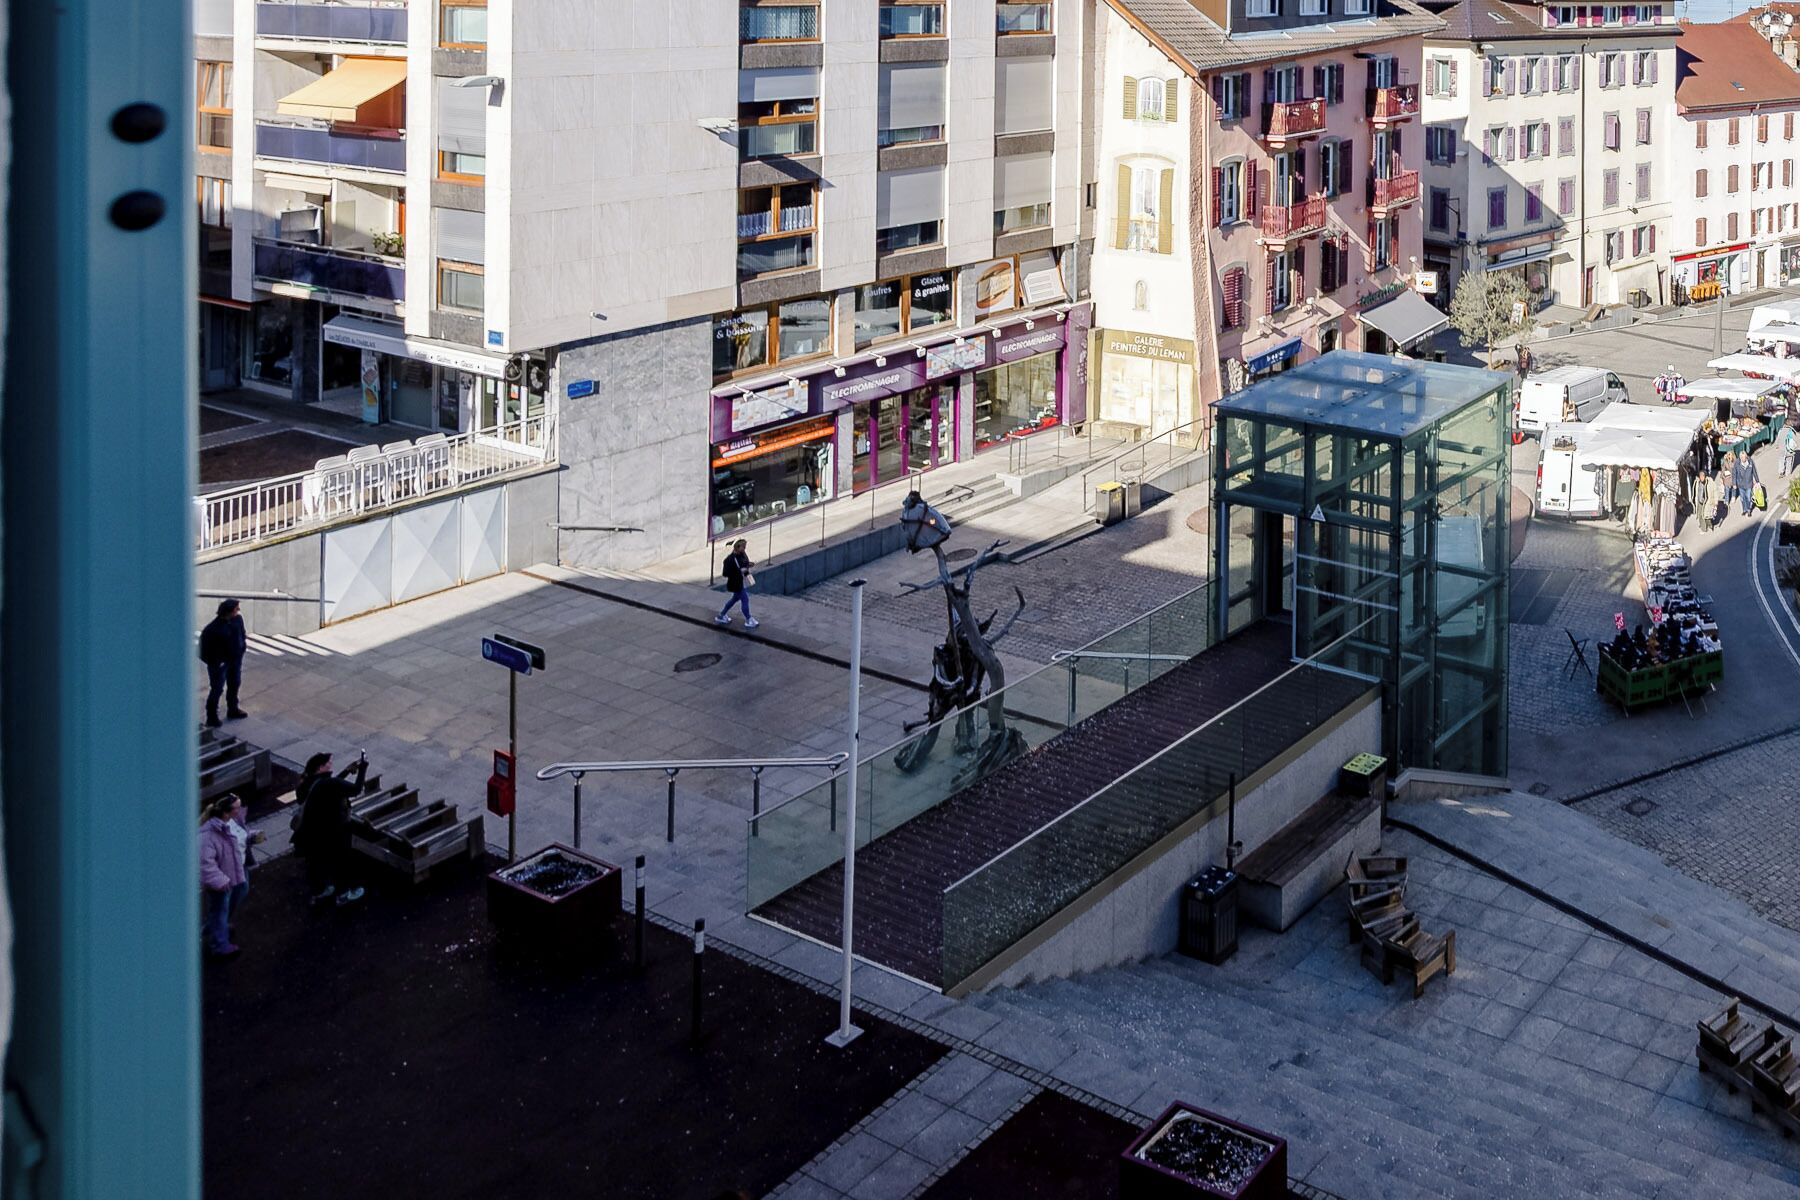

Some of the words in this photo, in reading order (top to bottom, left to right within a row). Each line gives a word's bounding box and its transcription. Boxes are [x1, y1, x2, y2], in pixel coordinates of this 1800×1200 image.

[1135, 336, 1164, 347] GALERIE
[1111, 342, 1147, 354] PEINTRES
[1148, 347, 1158, 356] DU
[1160, 348, 1185, 360] LEMAN
